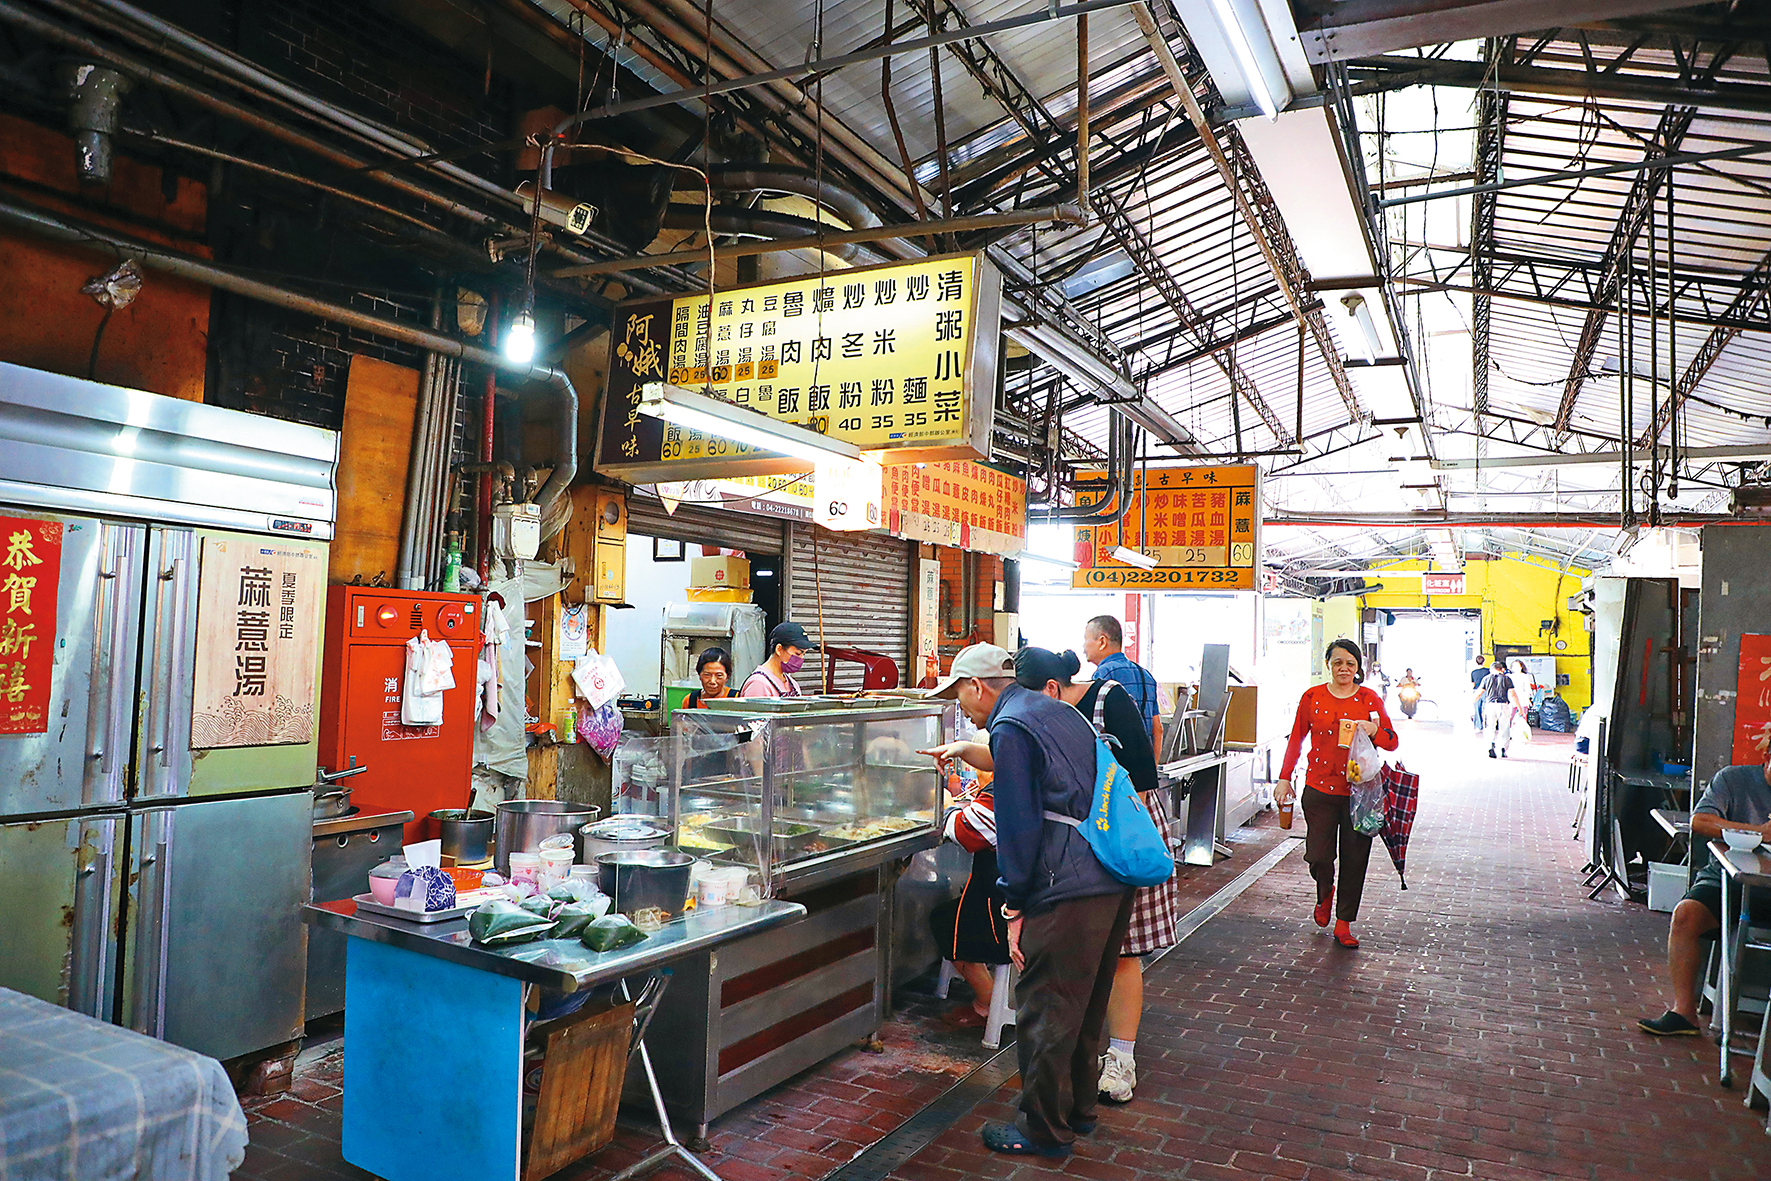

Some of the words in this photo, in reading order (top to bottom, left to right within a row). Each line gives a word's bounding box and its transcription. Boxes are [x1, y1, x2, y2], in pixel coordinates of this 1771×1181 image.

[737, 298, 755, 364] 丸仔湯
[760, 295, 778, 362] 豆腐湯
[777, 291, 804, 414] 魯肉飯
[838, 282, 865, 409] 炒冬粉
[870, 278, 897, 406] 炒米粉
[933, 269, 964, 422] 清粥小菜
[670, 369, 689, 384] 60
[712, 366, 728, 381] 60
[738, 366, 750, 375] 25
[761, 365, 774, 374] 25
[620, 383, 642, 458] 古早味
[838, 417, 862, 431] 40
[871, 415, 894, 429] 35
[904, 412, 927, 426] 35
[662, 442, 682, 458] 60
[707, 439, 727, 455] 60
[829, 501, 848, 516] 60
[1153, 493, 1169, 546] 炒米粉
[1171, 493, 1187, 546] 味噌湯
[1190, 492, 1206, 546] 苦瓜湯
[1209, 492, 1225, 546] 豬血湯
[1185, 548, 1206, 563] 25
[1233, 543, 1252, 562] 60
[1086, 570, 1239, 586] (04)22201732
[0, 528, 43, 703] 恭賀新禧
[279, 571, 296, 640] 夏季限定
[385, 695, 400, 703] FIRE
[1099, 792, 1110, 817] Jack
